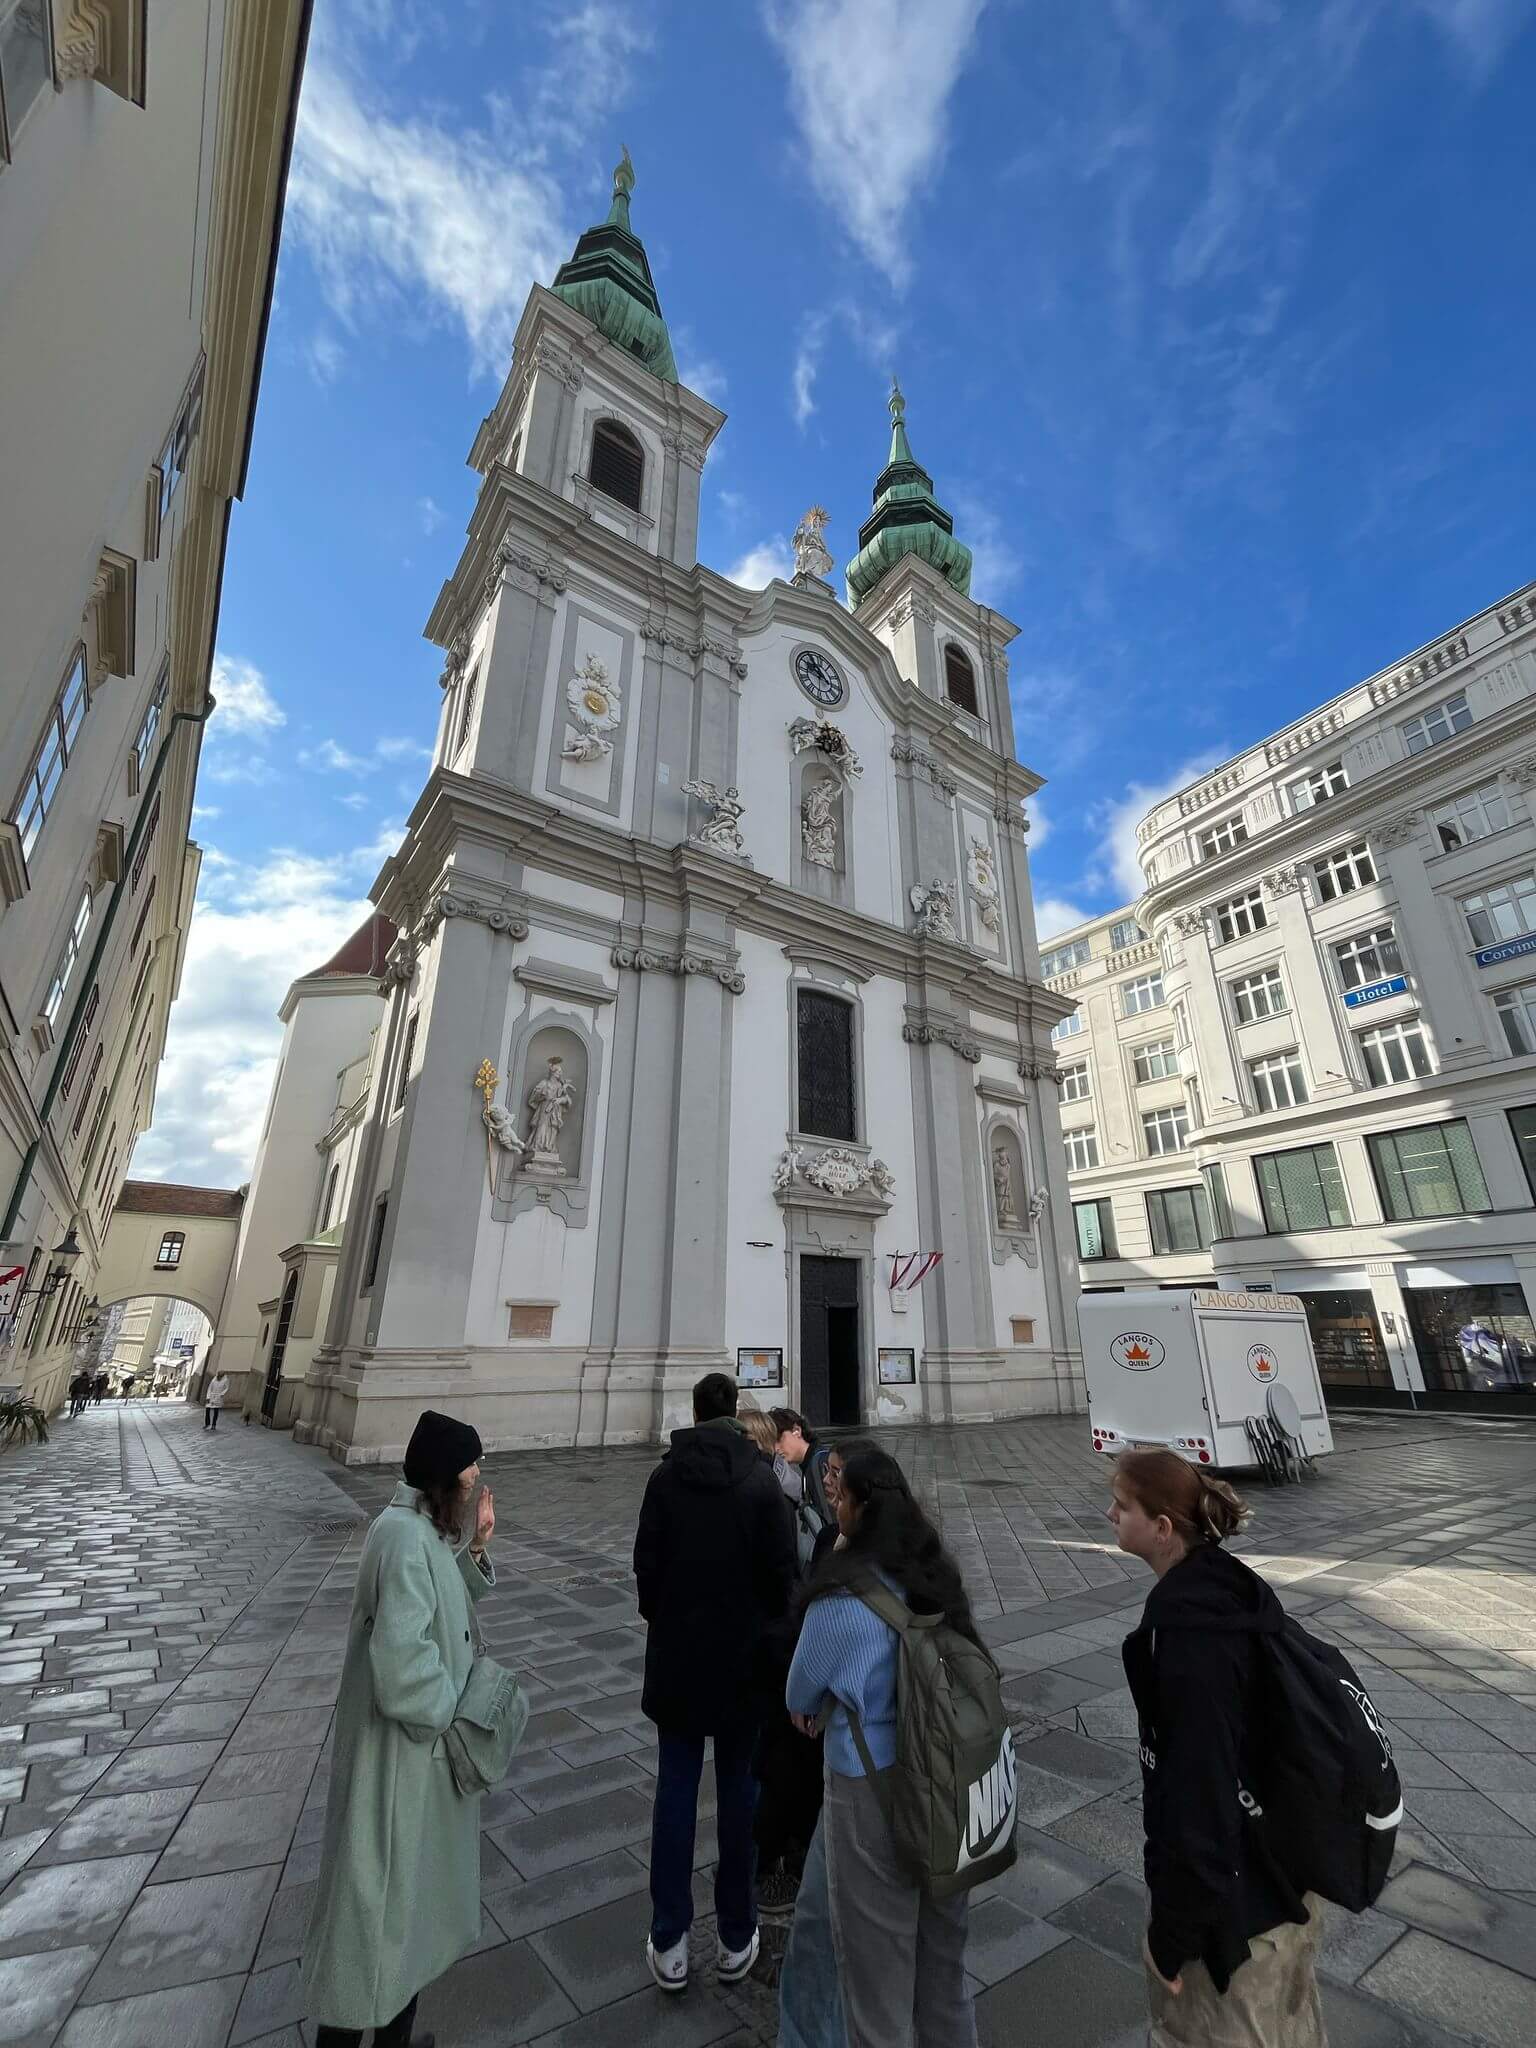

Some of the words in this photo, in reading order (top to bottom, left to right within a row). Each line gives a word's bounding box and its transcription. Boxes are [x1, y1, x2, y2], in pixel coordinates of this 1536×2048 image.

[1355, 982, 1393, 1003] Hotel
[1199, 1292, 1256, 1309] LANGOS
[1259, 1294, 1300, 1311] QUEEN
[1117, 1335, 1154, 1346] LANGOS
